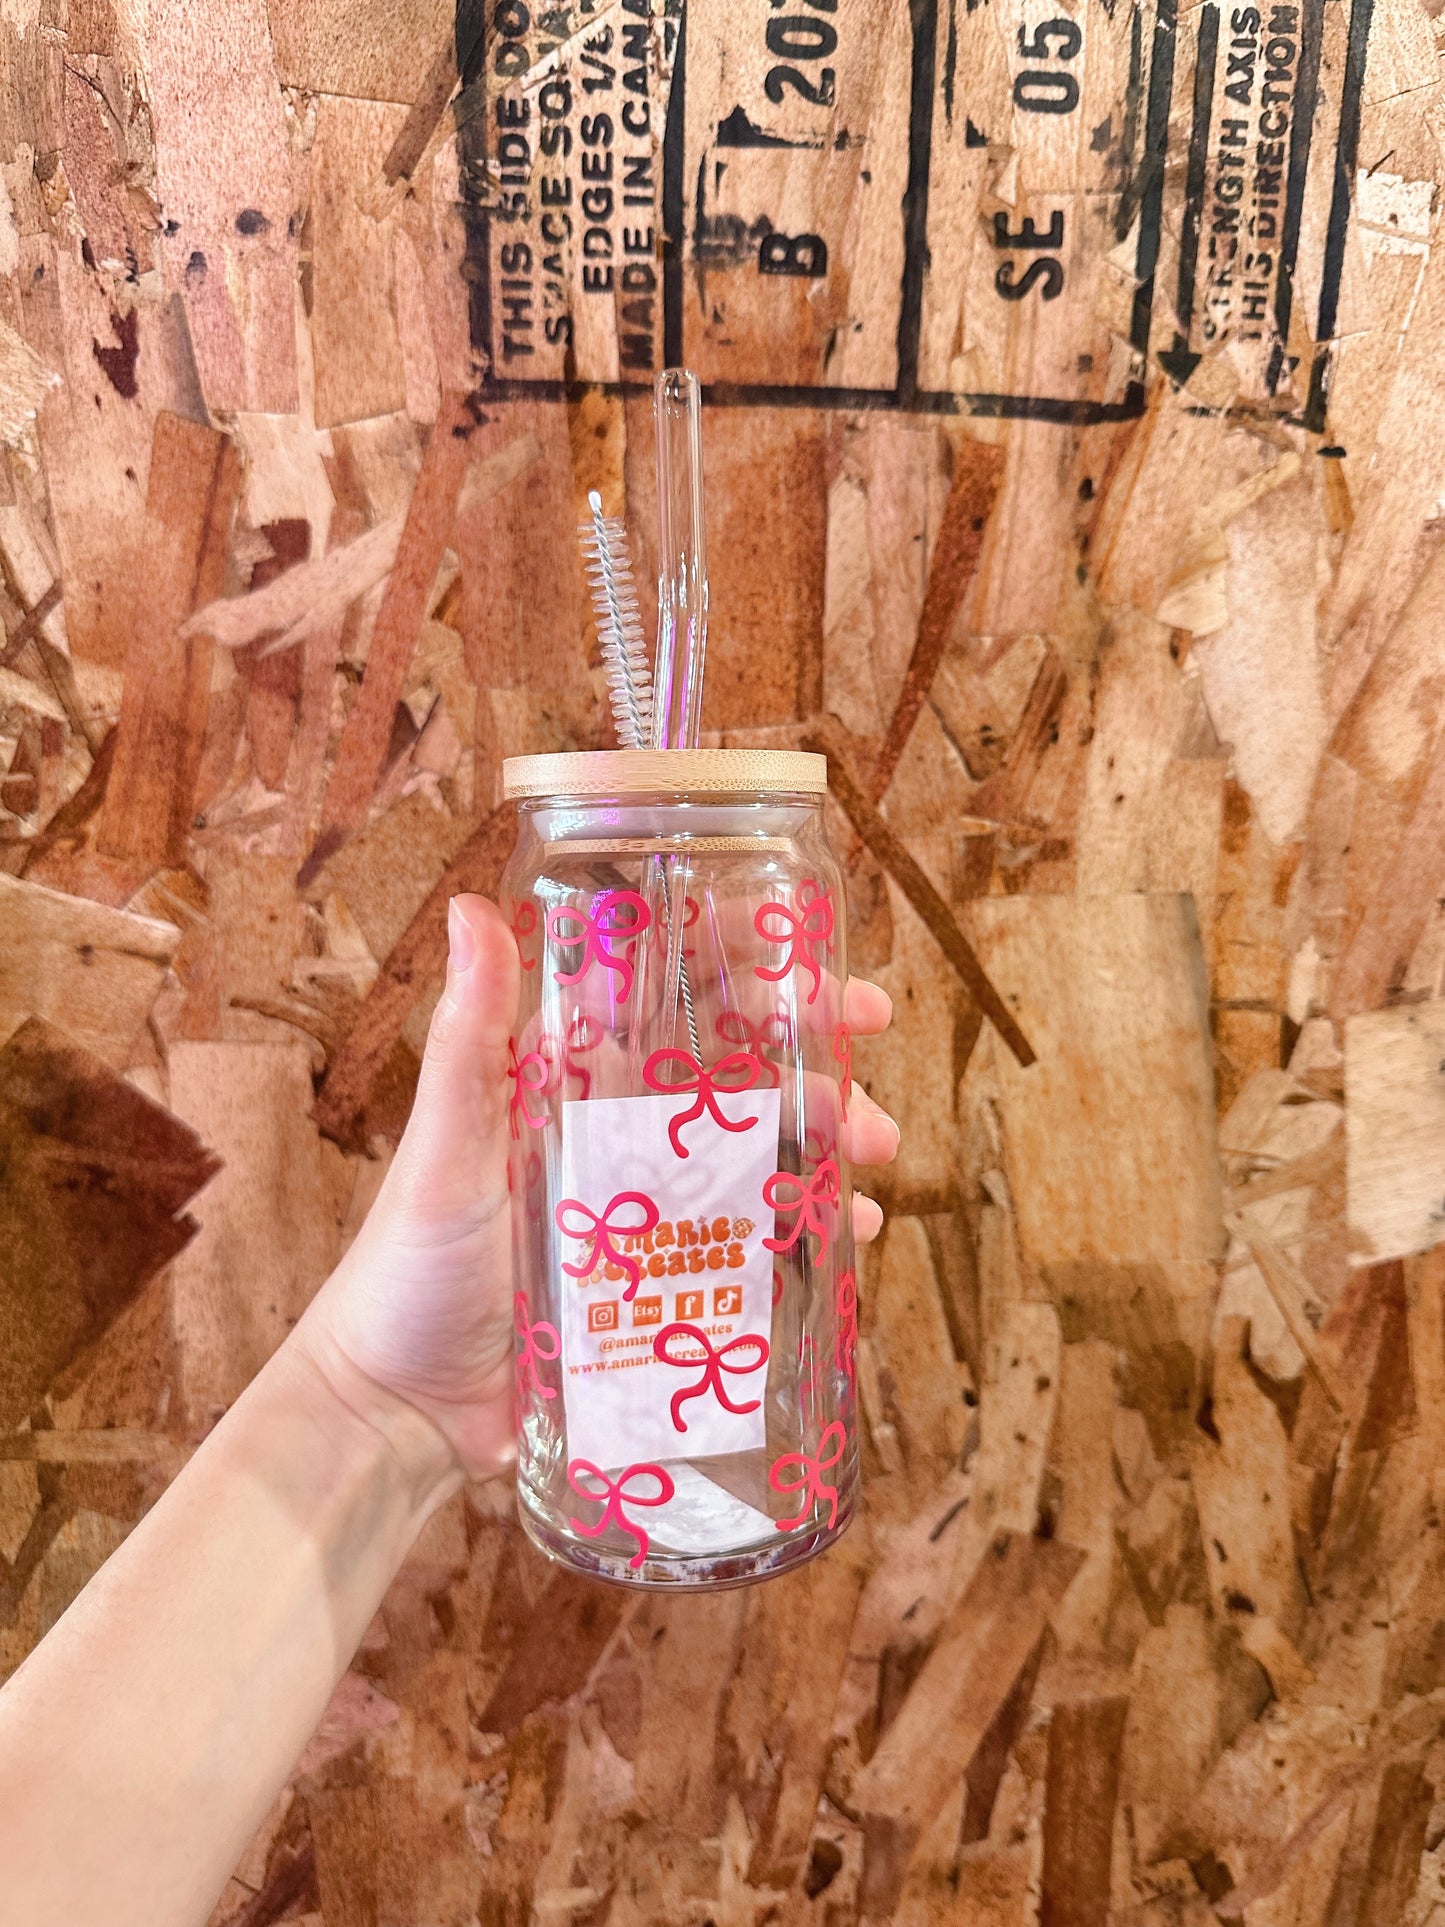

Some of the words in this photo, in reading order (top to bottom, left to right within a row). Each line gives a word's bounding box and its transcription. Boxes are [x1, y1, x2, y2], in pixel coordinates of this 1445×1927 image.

[1012, 18, 1082, 115] 05
[1224, 7, 1262, 106] AXIS
[498, 98, 533, 223] SIDE
[1250, 5, 1299, 238] DIRECTION
[581, 113, 615, 293] EDGES
[623, 156, 655, 207] IN
[501, 242, 537, 363] THIS
[621, 227, 656, 369] MADE
[758, 233, 828, 277] B
[994, 210, 1064, 301] SE
[1238, 253, 1273, 342] THIS
[634, 1304, 662, 1317] Etsy
